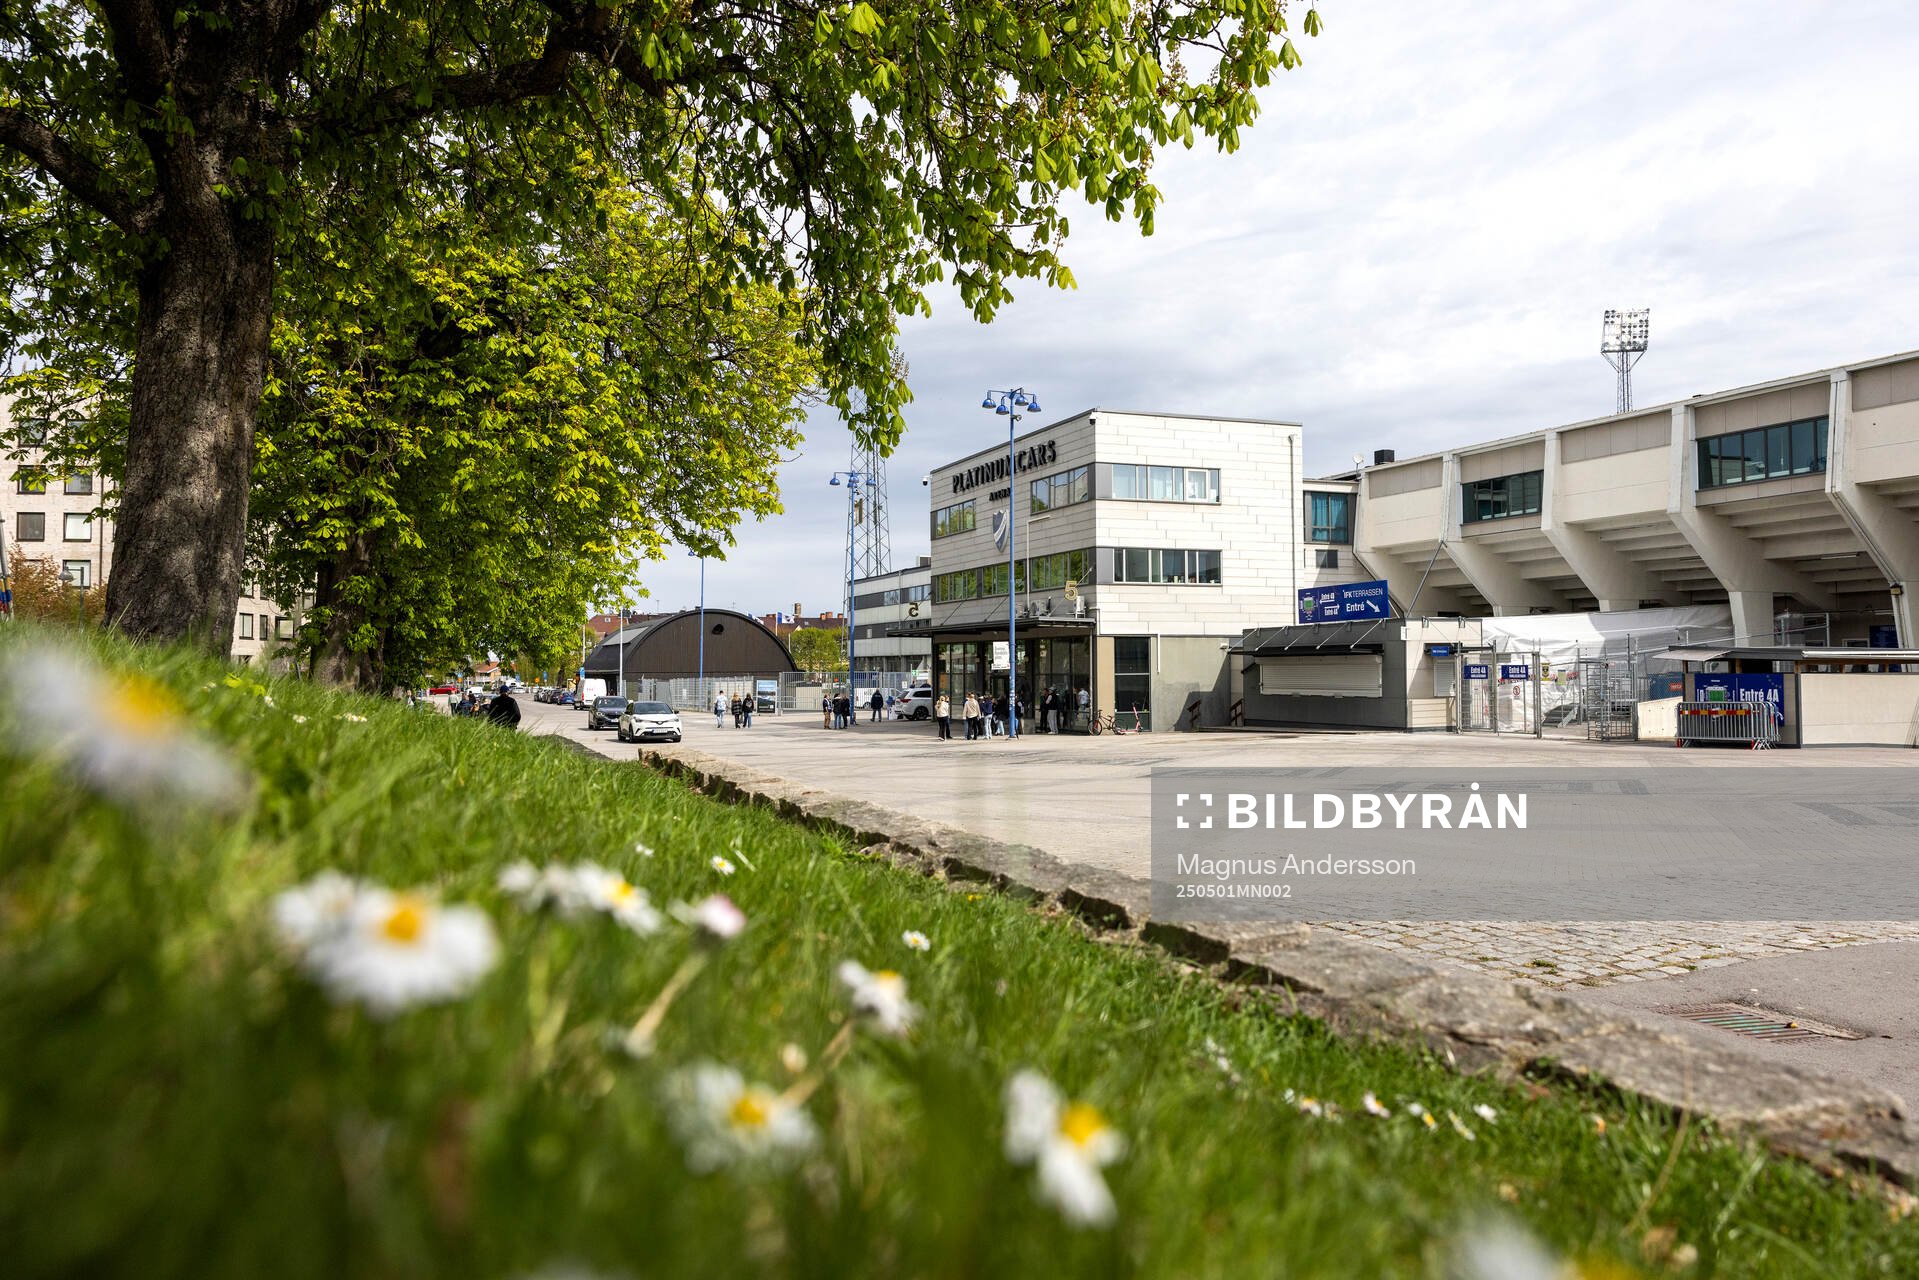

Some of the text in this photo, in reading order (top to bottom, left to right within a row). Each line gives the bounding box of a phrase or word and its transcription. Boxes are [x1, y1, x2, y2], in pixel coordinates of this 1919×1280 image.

[1064, 581, 1079, 600] 5
[1346, 601, 1365, 612] Entré
[1740, 688, 1780, 702] Entré 4A
